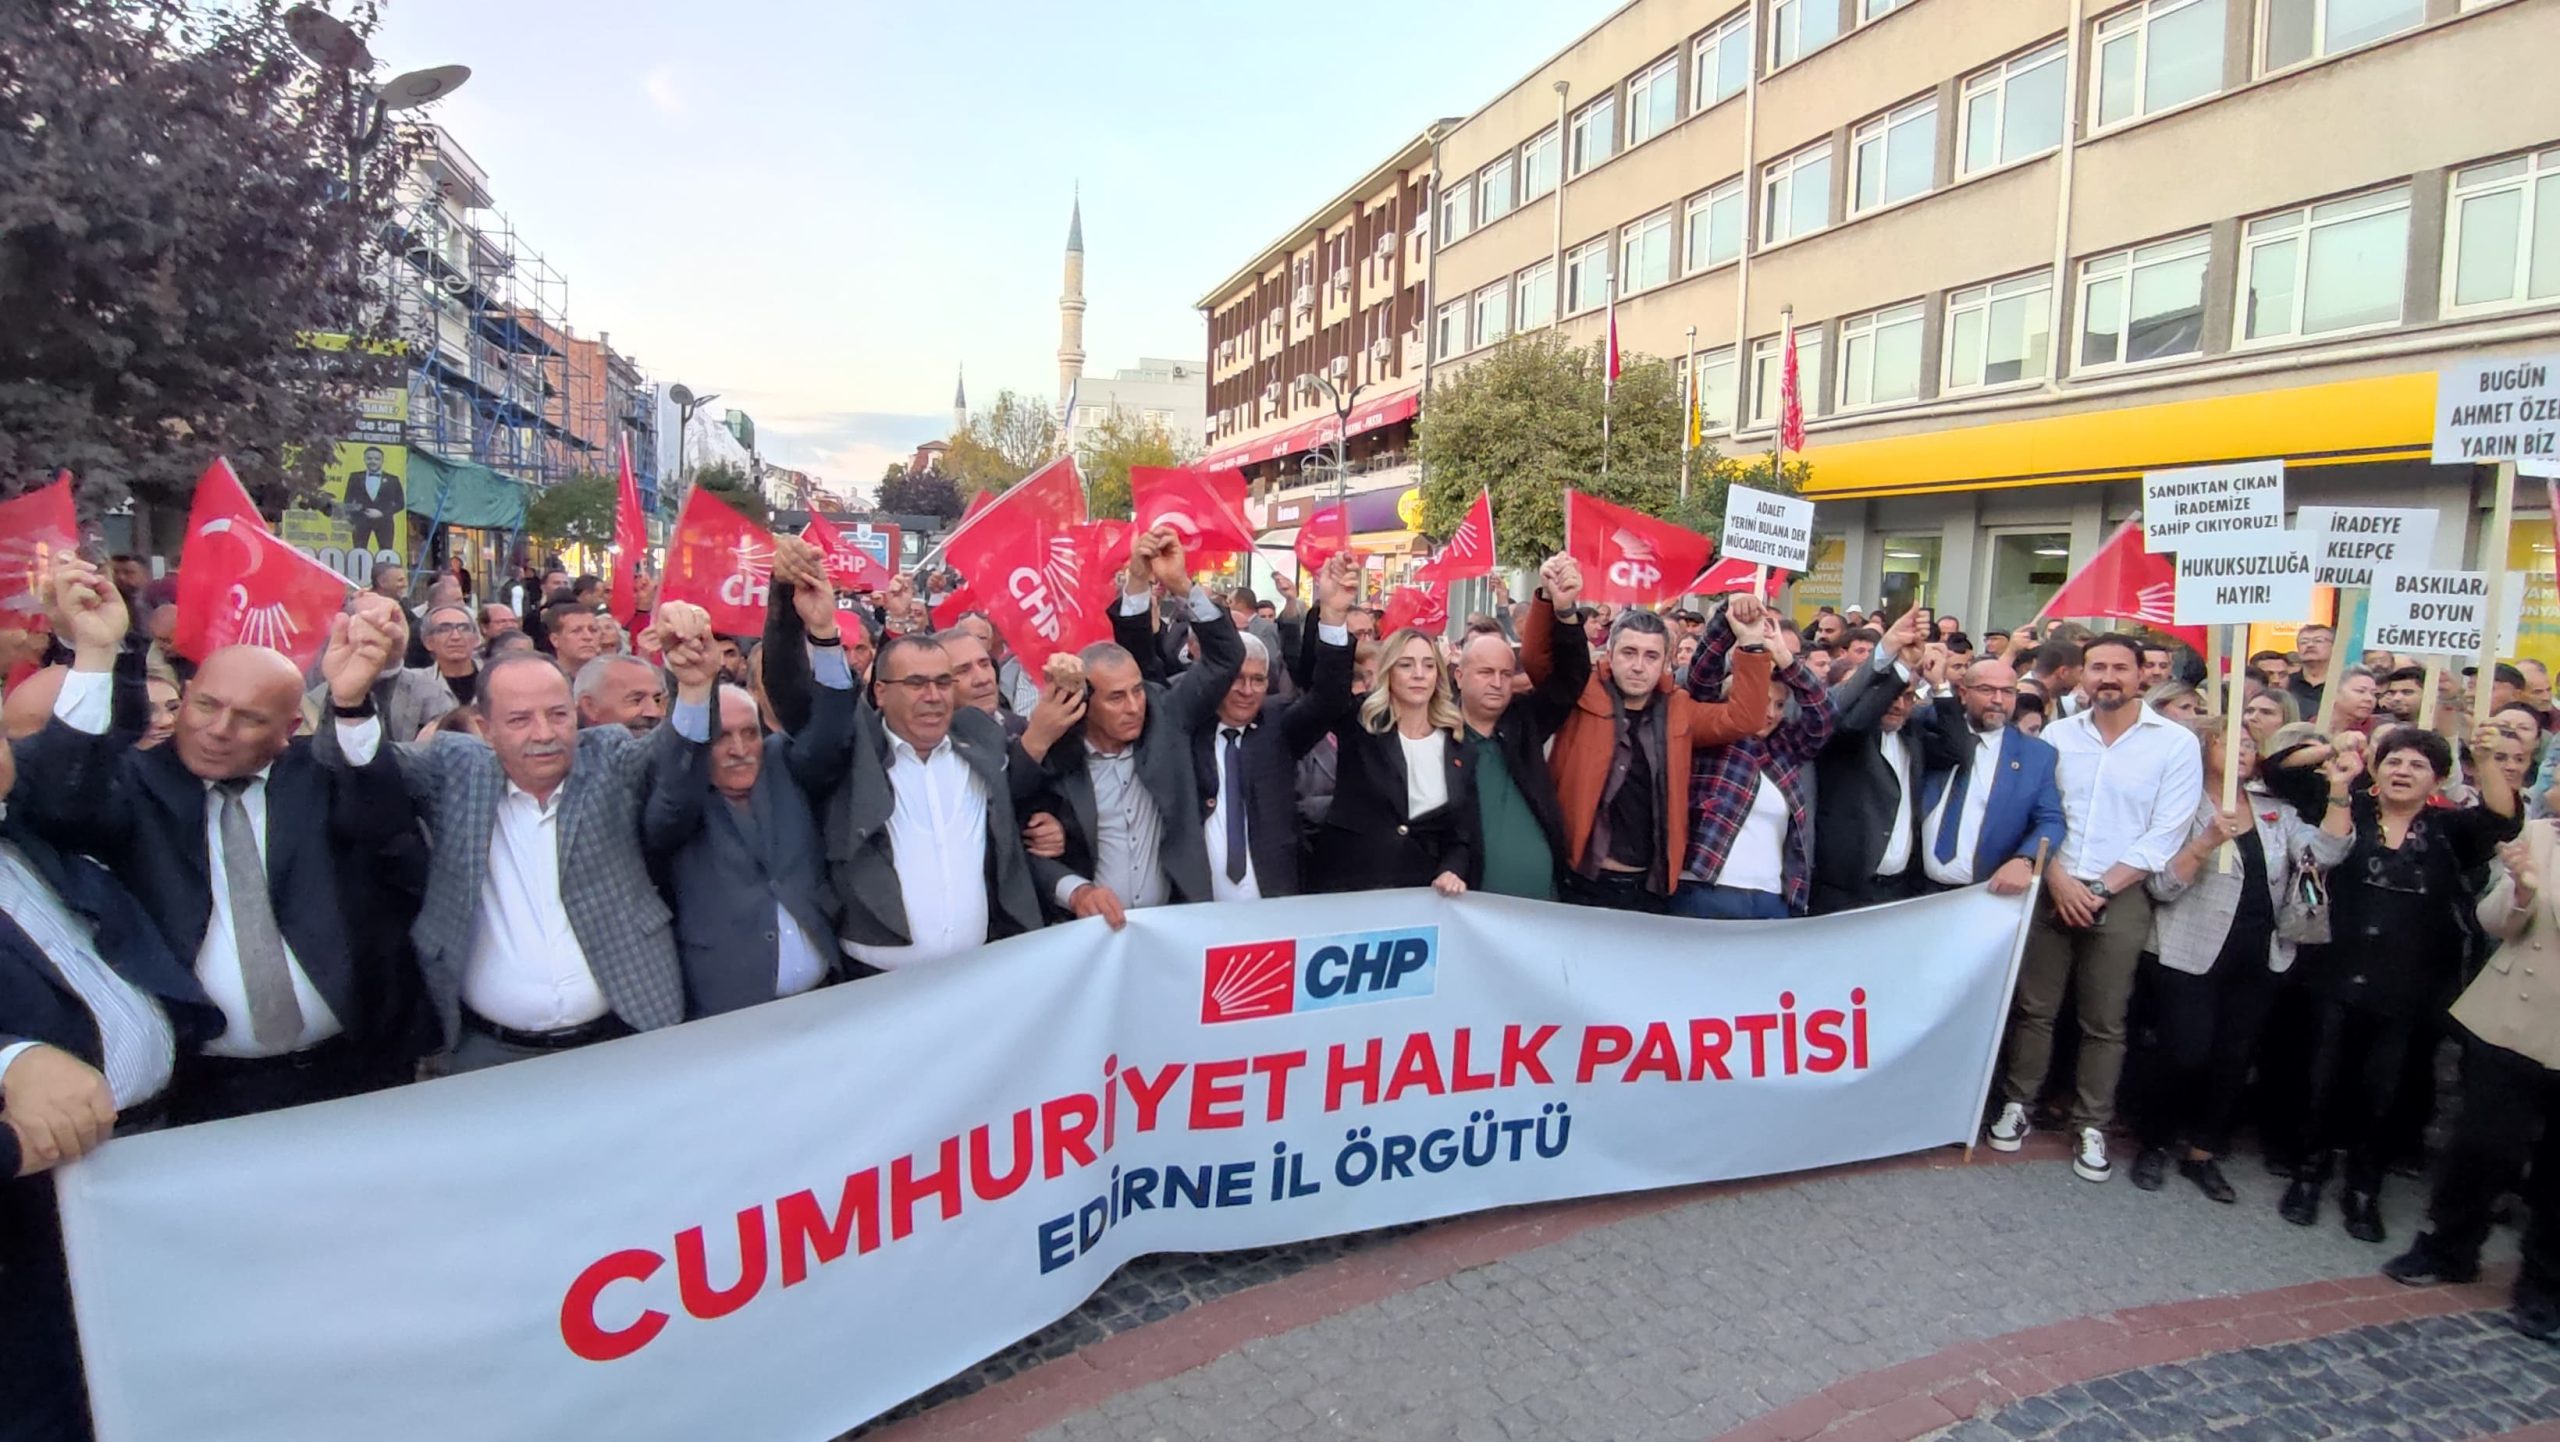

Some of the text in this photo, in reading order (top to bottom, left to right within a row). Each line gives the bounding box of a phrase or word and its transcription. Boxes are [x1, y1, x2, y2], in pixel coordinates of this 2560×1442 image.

[2479, 362, 2546, 393] BUGÜN
[2450, 396, 2560, 427] AHMET ÖZE
[2461, 427, 2556, 458] YARIN BİZ
[2149, 475, 2278, 499] SANDIKTAN ÇIKAN
[1756, 501, 1786, 518] ADALET
[2174, 495, 2251, 516] İRADEMİZE
[1731, 514, 1807, 543] YERİNİ BULANA DEK
[2150, 519, 2191, 537] SAHİP
[2330, 511, 2402, 534] İRADEYE
[1725, 533, 1806, 562] MÜCADELEYE DEVAM
[2326, 541, 2395, 564] KELEPÇE
[828, 553, 867, 573] CHP
[1608, 560, 1662, 591] CHP
[2181, 550, 2310, 578] HUKUKSUZLUĞA
[720, 573, 769, 607] CH
[1008, 565, 1061, 643] CHP
[2216, 585, 2271, 605] HAYIR!
[2409, 602, 2474, 623] BOYUN
[1304, 937, 1430, 1000] CHP
[560, 986, 1869, 1362] CUMHURİYET HALK PARTİSİ
[1038, 1101, 1572, 1276] EDİRNE İL ÖRGÜTÜ
